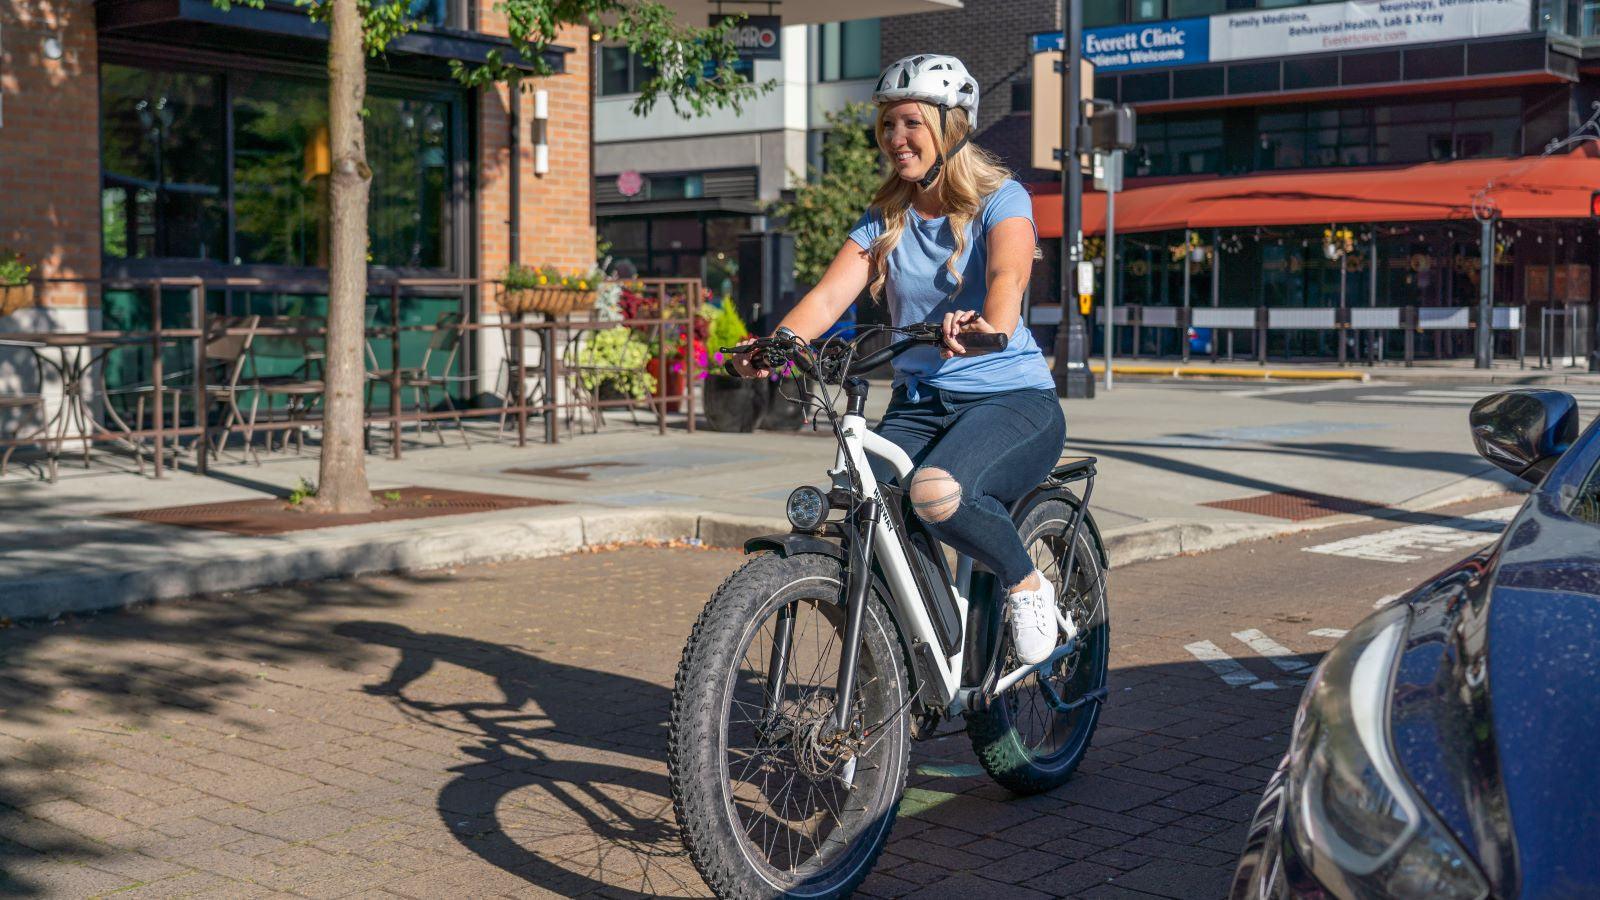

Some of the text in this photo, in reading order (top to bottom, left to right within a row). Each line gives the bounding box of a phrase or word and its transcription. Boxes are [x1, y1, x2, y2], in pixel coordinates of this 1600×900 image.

[1229, 12, 1310, 28] Family Medicine,
[1288, 22, 1343, 37] Behavioral
[1344, 18, 1380, 30] Health,
[1384, 15, 1402, 27] Lab
[1416, 13, 1444, 24] X-ray
[1086, 34, 1137, 53] Everett
[1140, 27, 1185, 48] Clinic
[1130, 49, 1185, 64] Welcome
